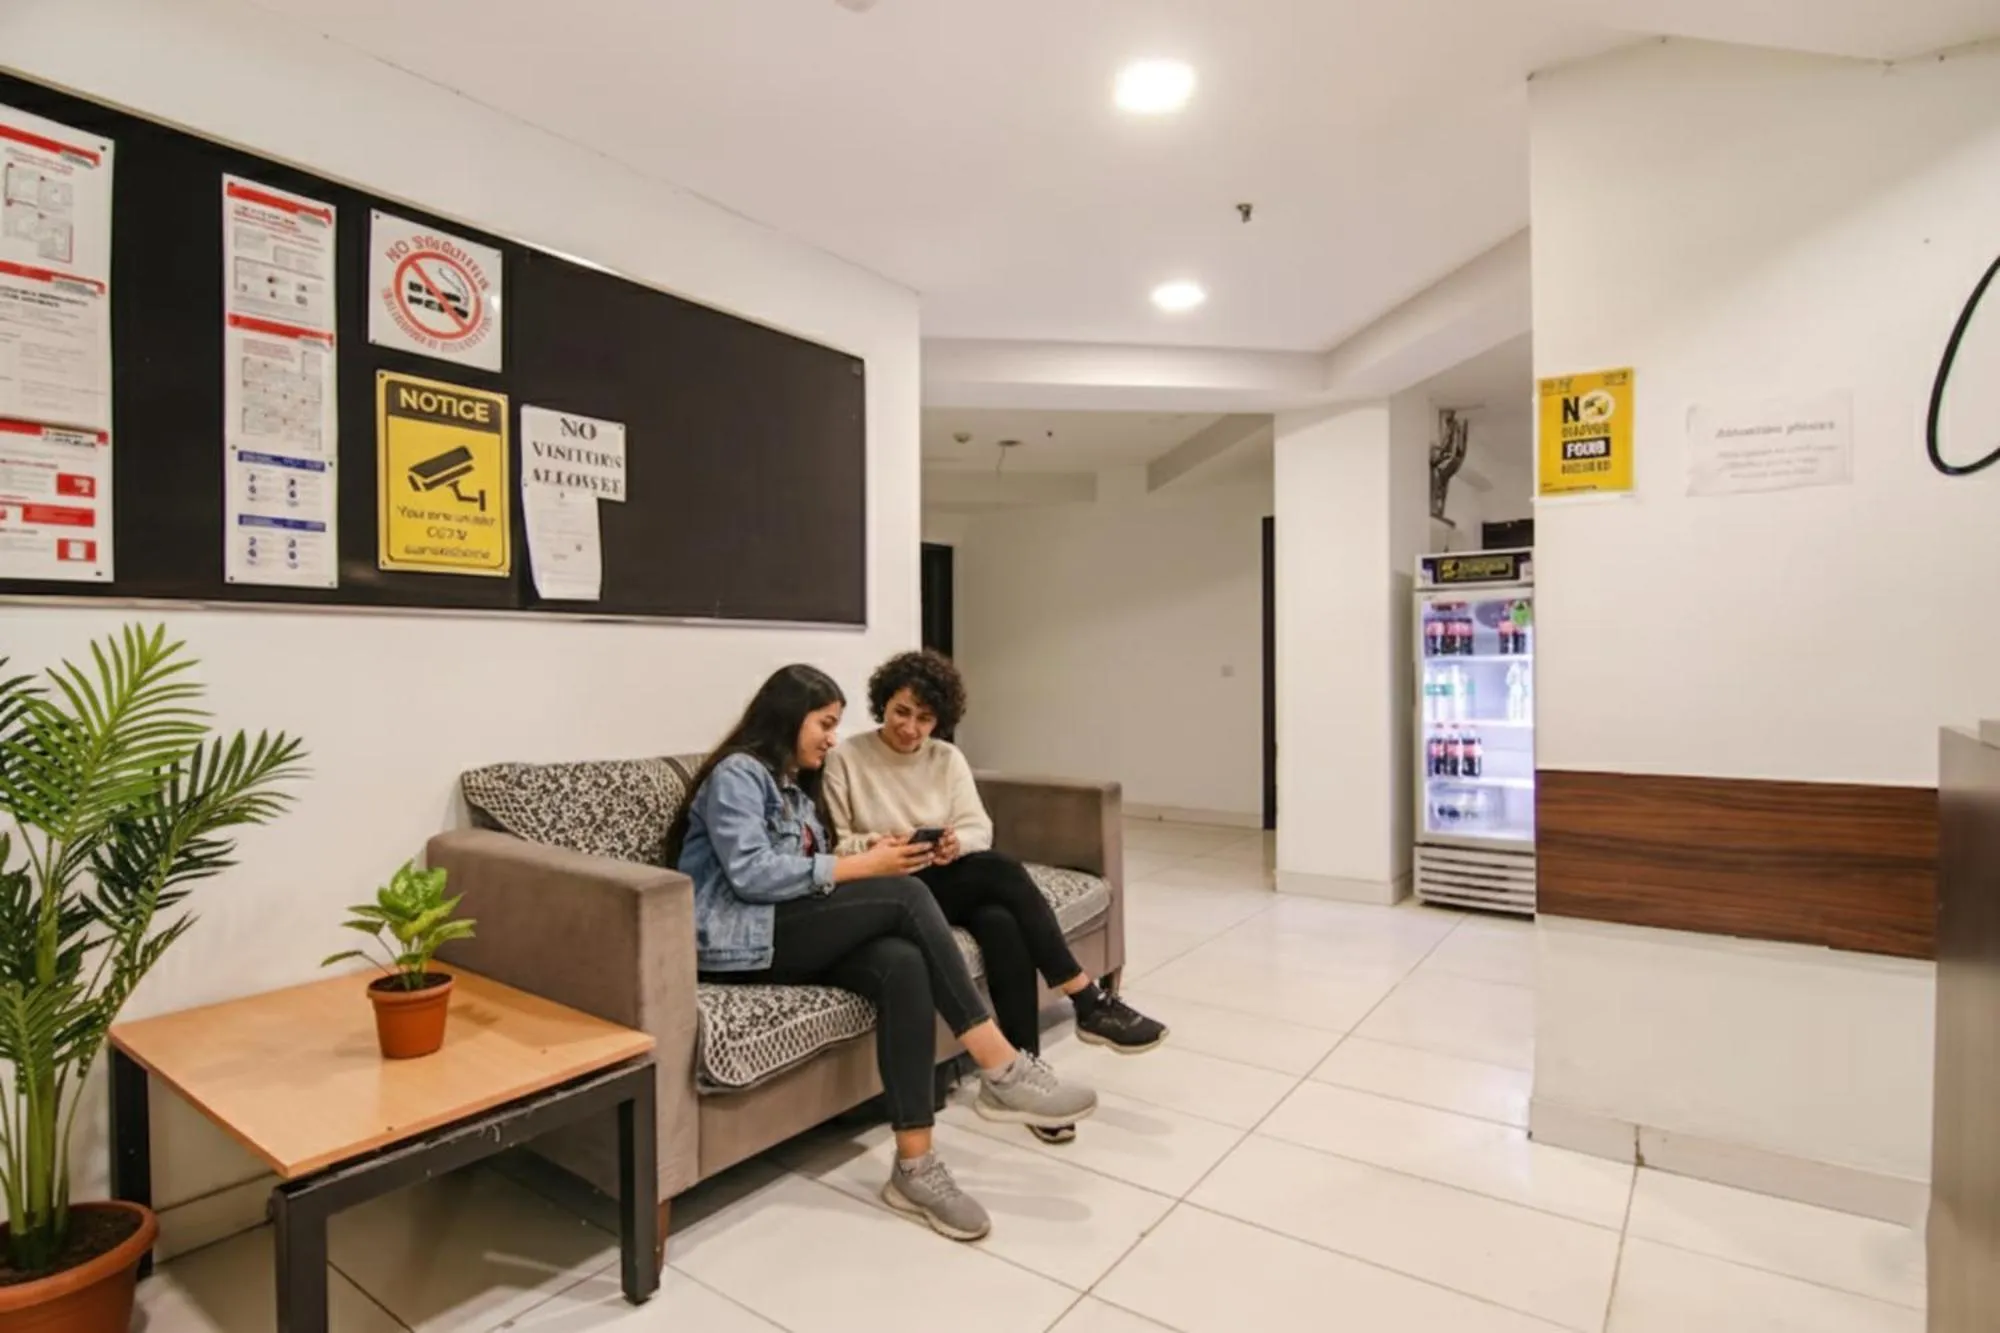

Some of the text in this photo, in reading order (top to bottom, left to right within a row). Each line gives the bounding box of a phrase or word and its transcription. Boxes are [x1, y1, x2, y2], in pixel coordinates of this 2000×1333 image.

[385, 240, 410, 263] NO
[399, 387, 490, 424] NOTICE
[560, 417, 597, 441] NO
